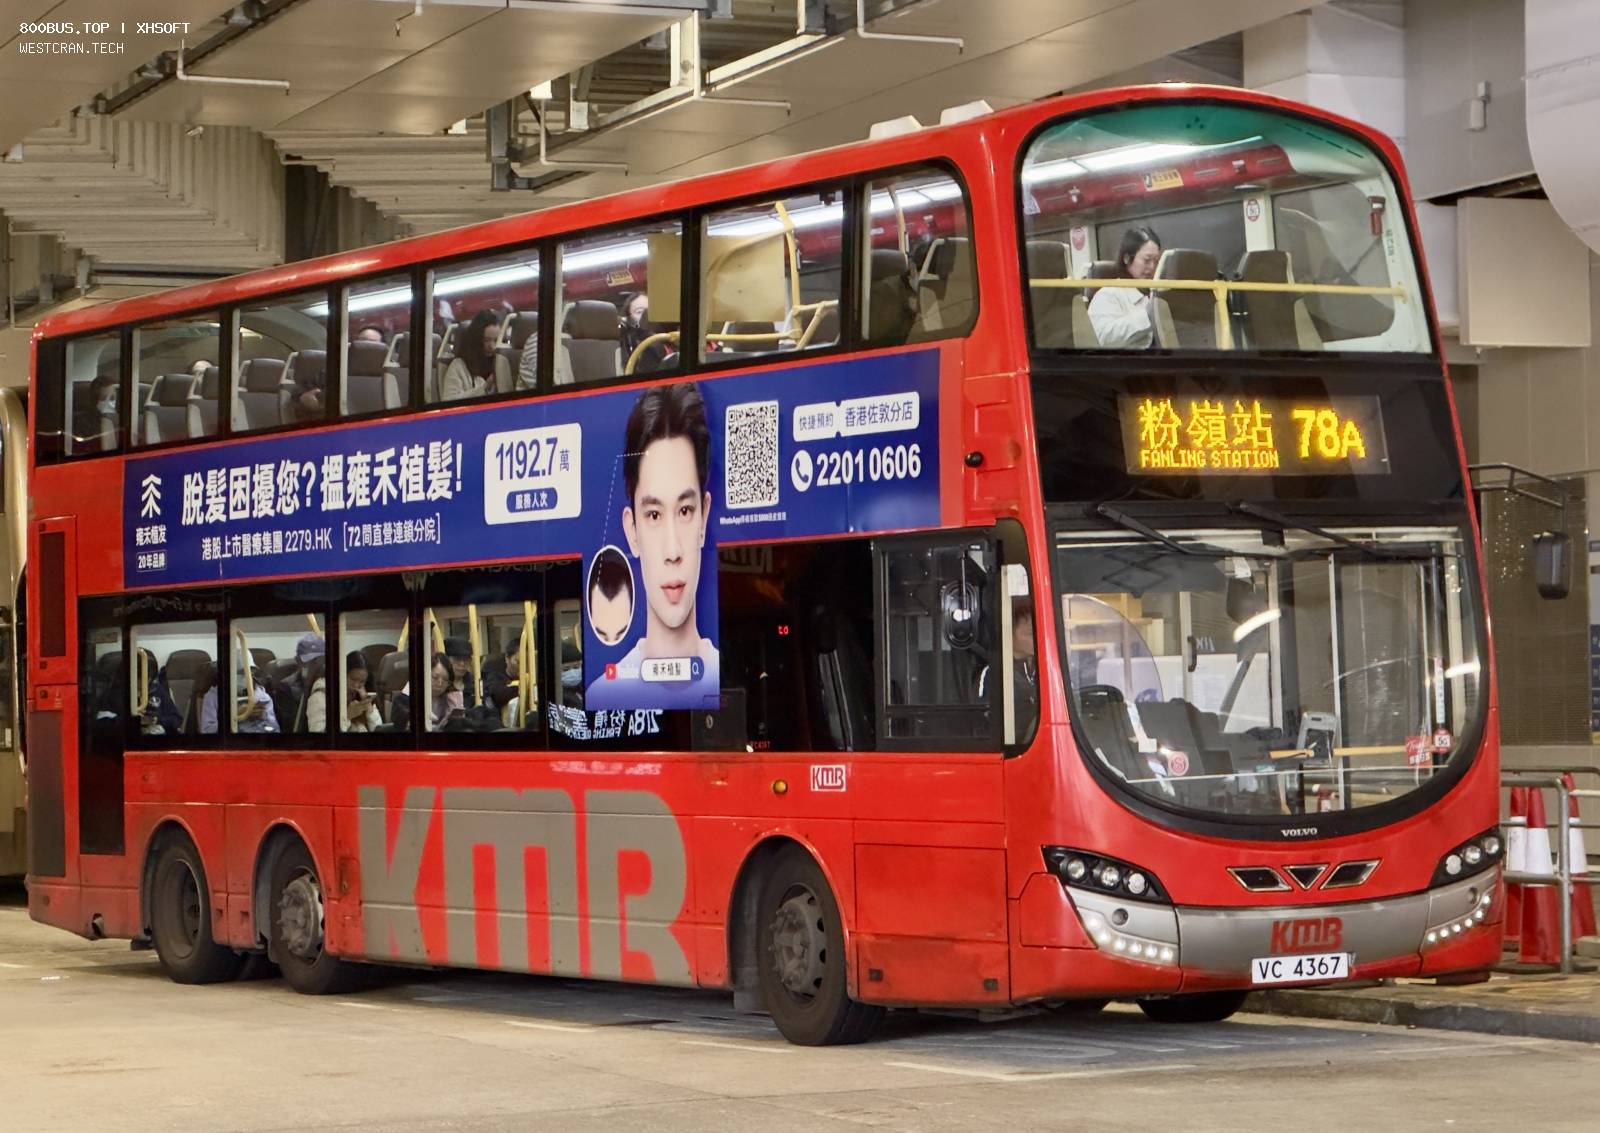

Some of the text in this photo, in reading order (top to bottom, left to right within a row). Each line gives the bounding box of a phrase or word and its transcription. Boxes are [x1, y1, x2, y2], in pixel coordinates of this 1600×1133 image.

[798, 412, 834, 431] 快捷預約
[844, 400, 914, 428] 香港佐敦分店
[1139, 399, 1366, 458] 粉嶺站 78A
[1140, 449, 1280, 468] FANLING STATION
[285, 527, 333, 553] 2279.HK
[811, 766, 845, 790] KMB
[1281, 827, 1318, 838] VOLVO
[357, 785, 700, 987] KMB
[1270, 917, 1344, 955] KMB
[1259, 956, 1341, 980] VC 4367
